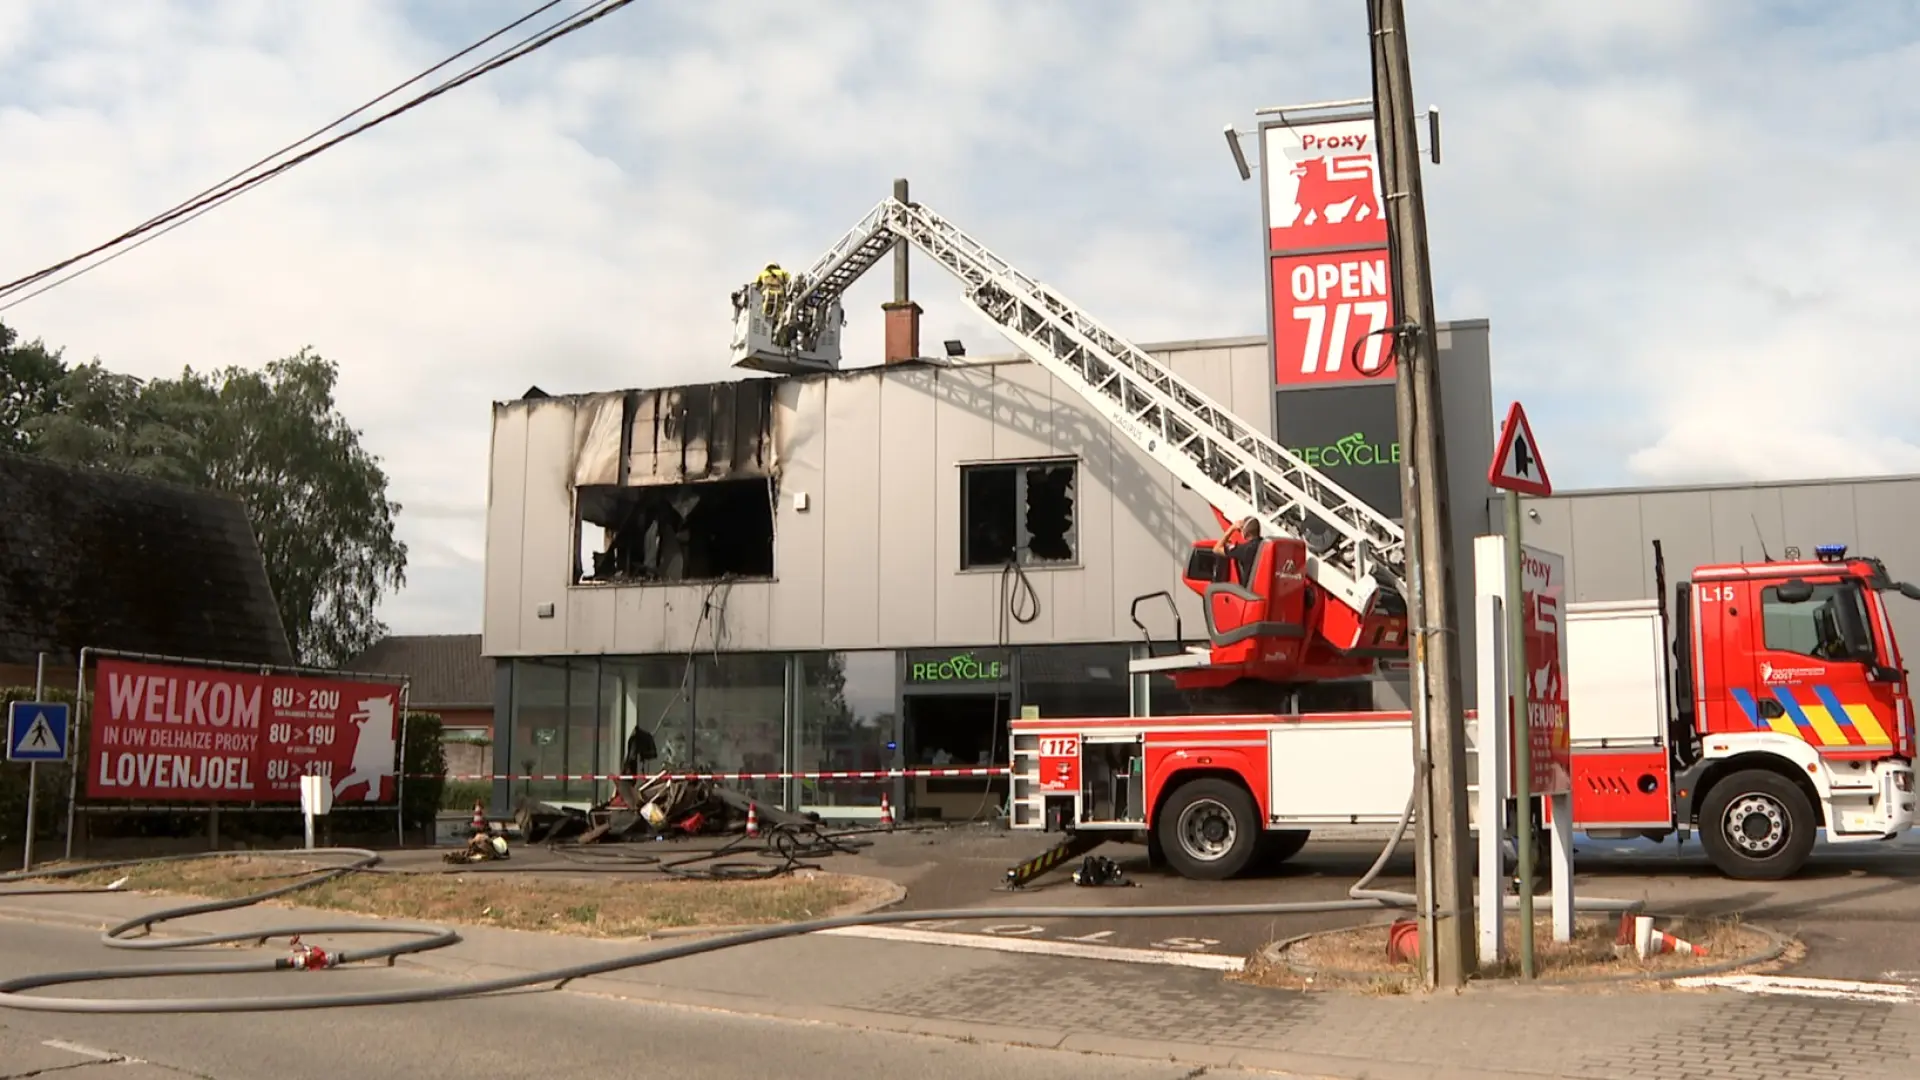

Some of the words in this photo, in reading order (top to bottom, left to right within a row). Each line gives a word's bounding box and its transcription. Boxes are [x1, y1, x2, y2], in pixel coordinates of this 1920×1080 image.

[1302, 133, 1367, 150] Proxy
[1291, 259, 1386, 302] OPEN
[1293, 300, 1388, 373] 7/7
[1520, 549, 1551, 588] Proxy
[1701, 586, 1734, 602] L15
[913, 654, 1002, 680] RECYCLE
[109, 672, 263, 729] WELKOM
[272, 687, 294, 708] 8U
[309, 689, 340, 710] 20U
[103, 725, 119, 745] IN
[123, 728, 147, 747] UW
[150, 729, 213, 750] DELHAIZE
[215, 733, 258, 751] PROXY
[269, 723, 291, 743] 8U
[307, 725, 335, 745] 19U
[1050, 740, 1076, 755] 112
[100, 751, 255, 790] LOVENJOEL
[267, 759, 289, 780] 8U
